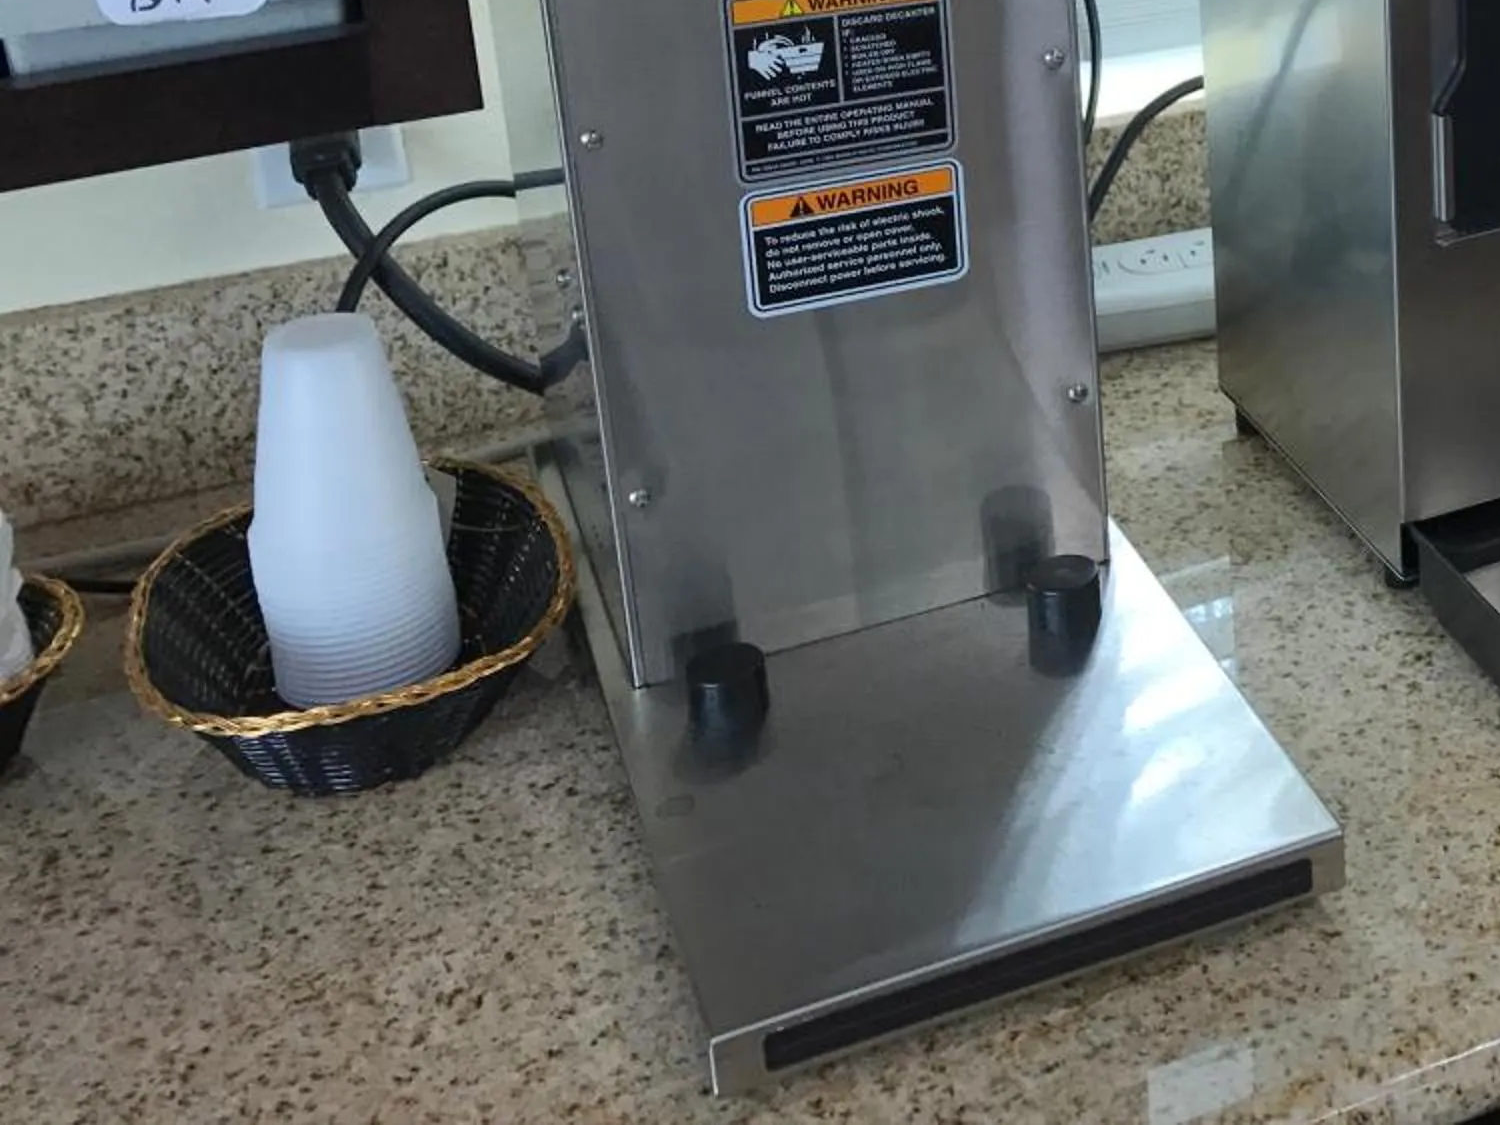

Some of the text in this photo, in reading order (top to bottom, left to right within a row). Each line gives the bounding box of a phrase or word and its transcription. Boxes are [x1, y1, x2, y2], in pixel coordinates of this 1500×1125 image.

[792, 91, 813, 104] HOT
[755, 119, 783, 133] READ
[783, 116, 803, 129] THE
[808, 134, 822, 145] TO
[815, 179, 920, 210] WARNING
[765, 235, 779, 246] To
[780, 229, 817, 244] reduce
[818, 226, 836, 238] the
[837, 221, 858, 234] risk
[859, 218, 872, 231] of
[872, 212, 910, 226] electric
[765, 247, 780, 258] do
[782, 244, 800, 256] not
[801, 238, 841, 253] remove
[843, 236, 855, 246] or
[856, 229, 883, 243] open
[767, 259, 783, 270] No
[784, 244, 870, 266] user-serviceable
[871, 237, 898, 253] parts
[768, 264, 825, 282] Authorized
[826, 255, 865, 271] service
[866, 246, 918, 265] personnel
[769, 275, 829, 294] Disconnect
[830, 267, 862, 283] power
[863, 258, 897, 275] before
